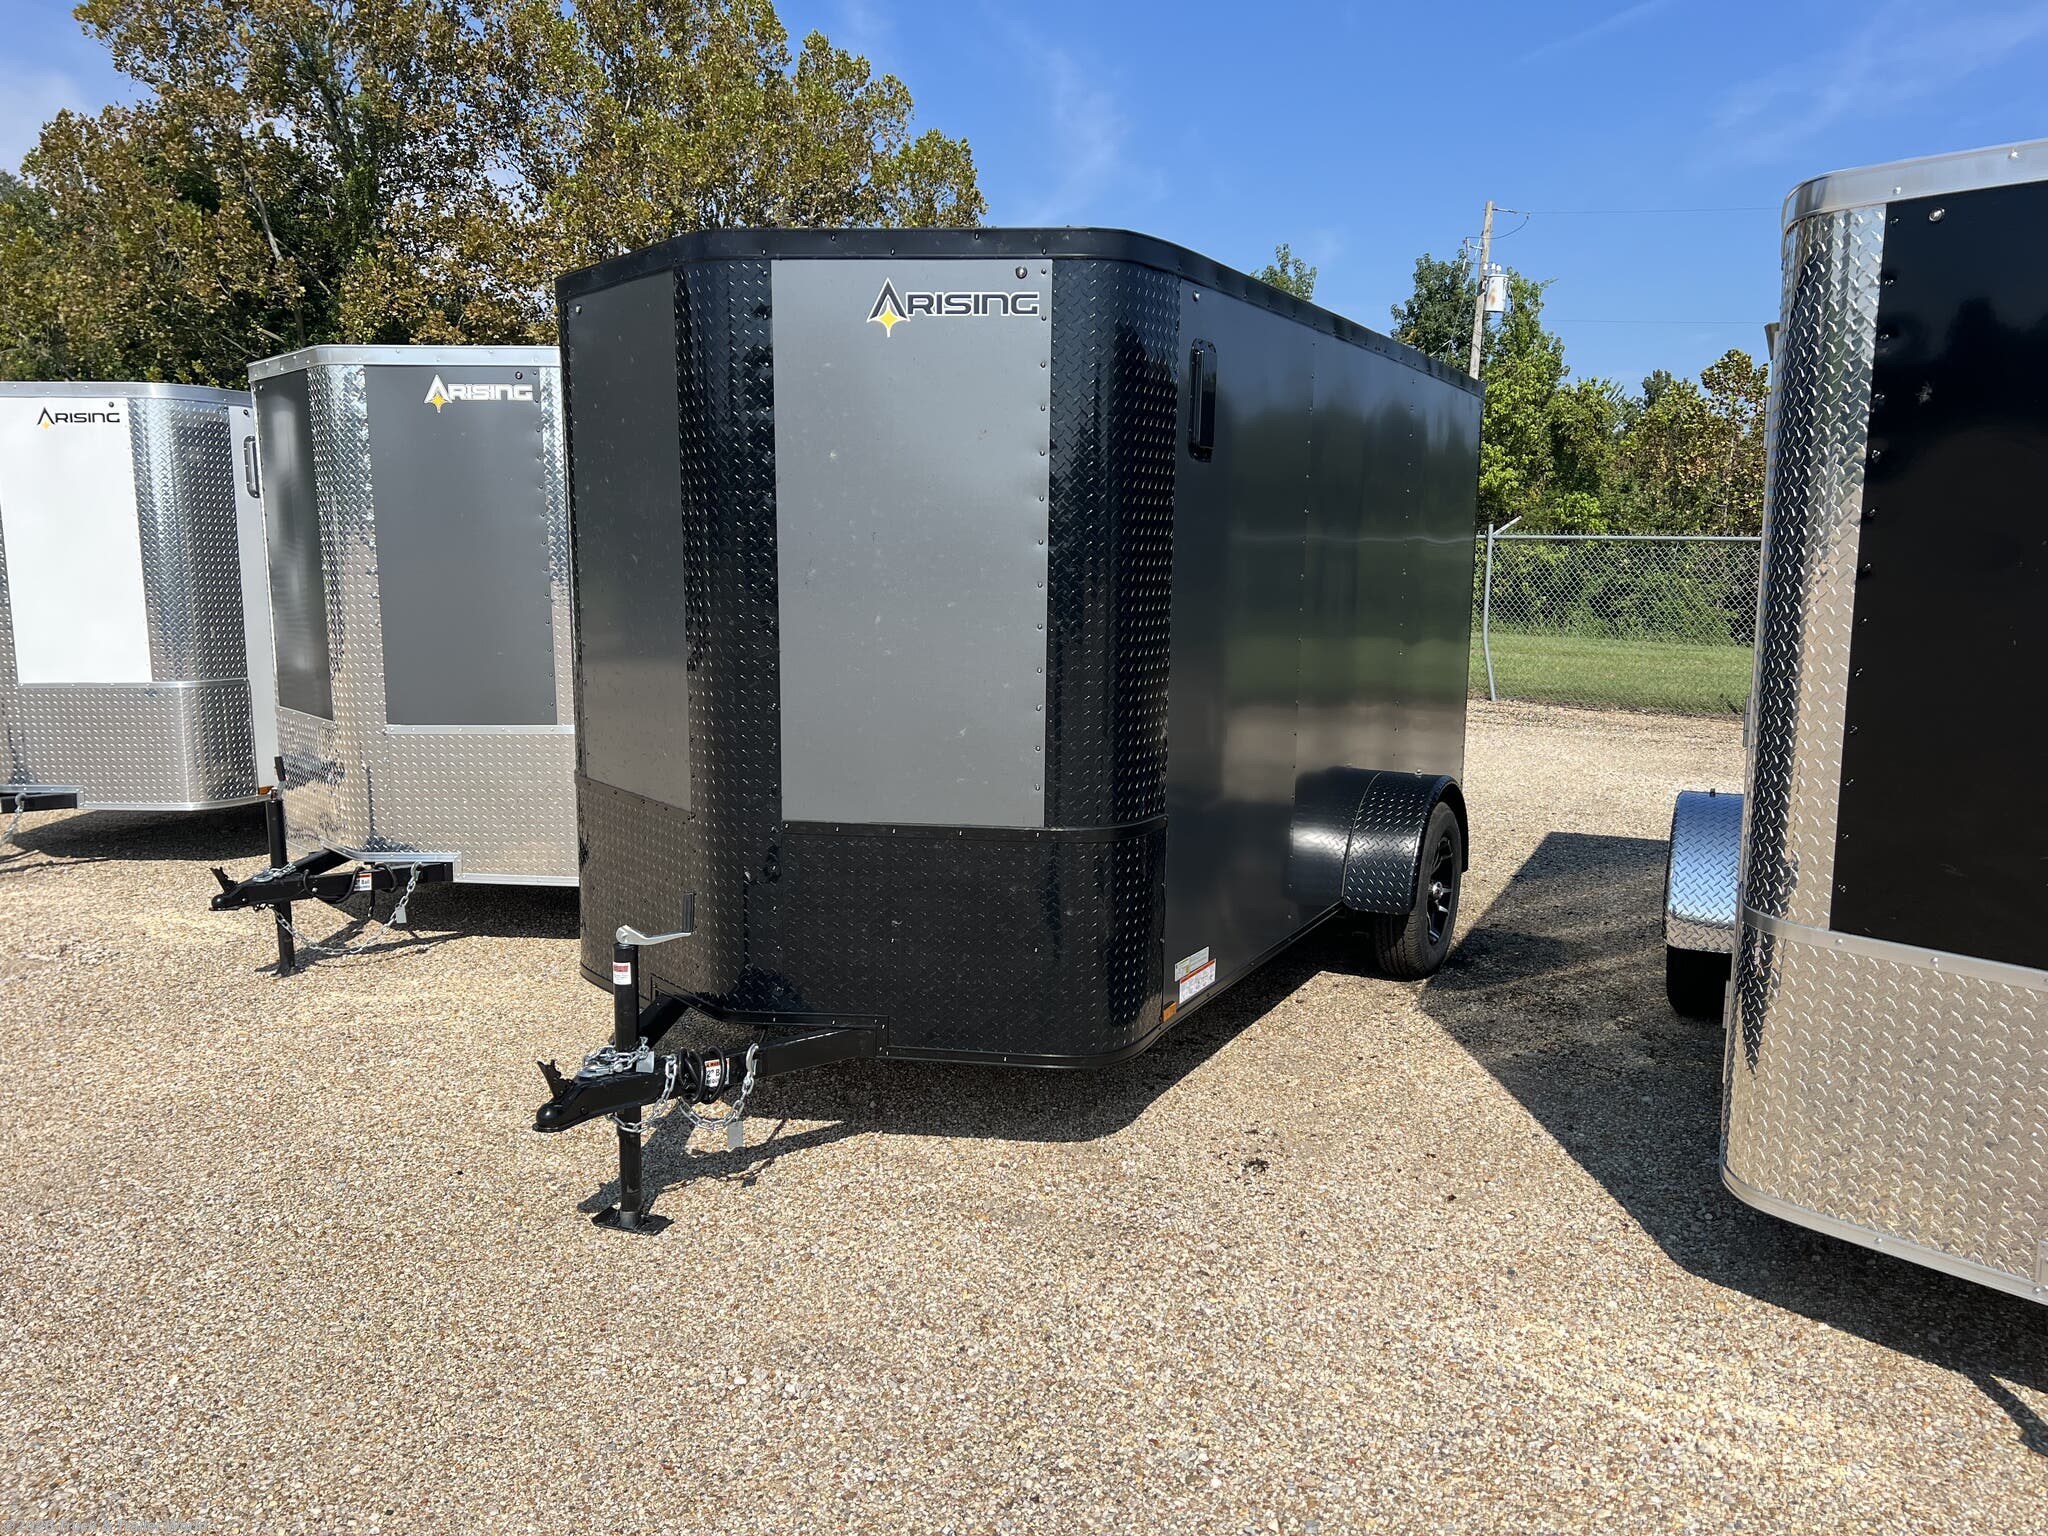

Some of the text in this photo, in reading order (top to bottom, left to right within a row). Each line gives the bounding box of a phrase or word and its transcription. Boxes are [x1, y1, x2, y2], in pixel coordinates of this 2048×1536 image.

[866, 277, 1039, 323] ARISING
[424, 374, 533, 404] ARISING
[37, 407, 120, 425] ARISING
